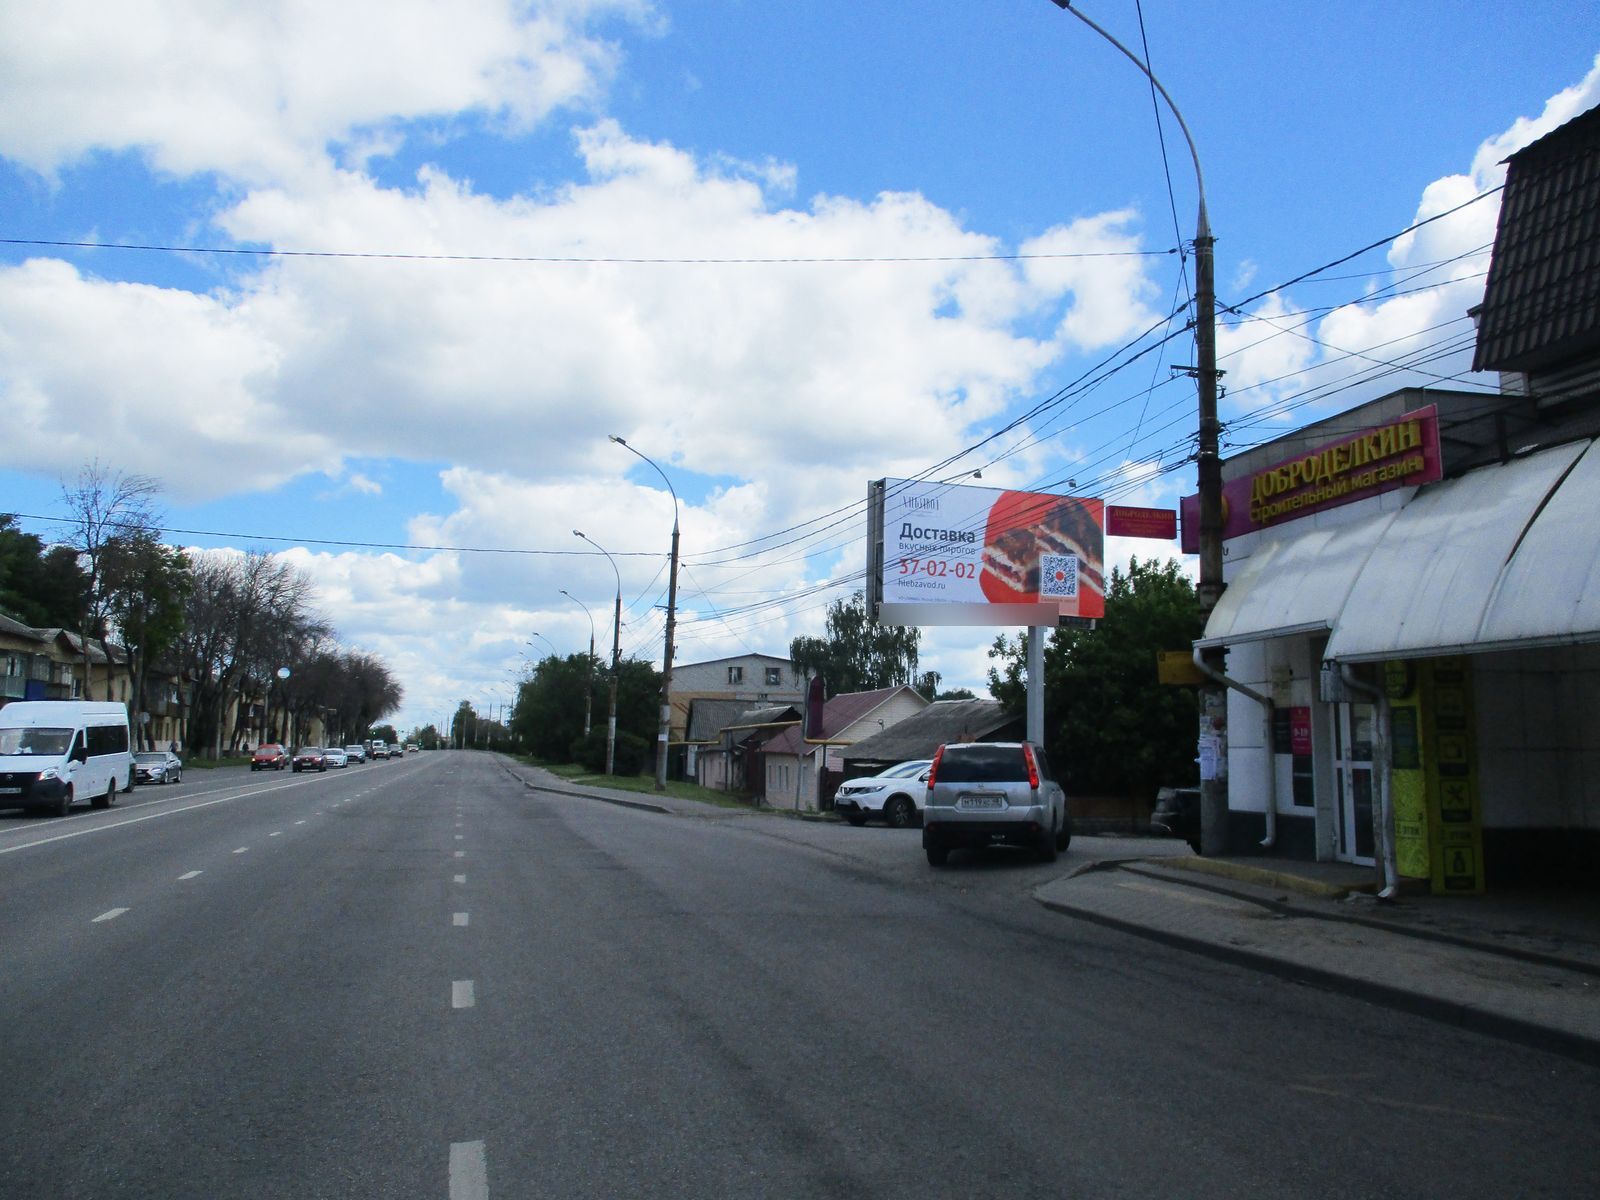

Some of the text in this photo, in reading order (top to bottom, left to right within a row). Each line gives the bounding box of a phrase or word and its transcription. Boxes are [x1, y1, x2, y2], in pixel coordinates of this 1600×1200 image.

[1250, 420, 1422, 505] ДОБРОДЕЛКИН
[1250, 457, 1424, 523] строительный магазин
[899, 523, 976, 543] Доставка
[899, 543, 937, 553] вкусных
